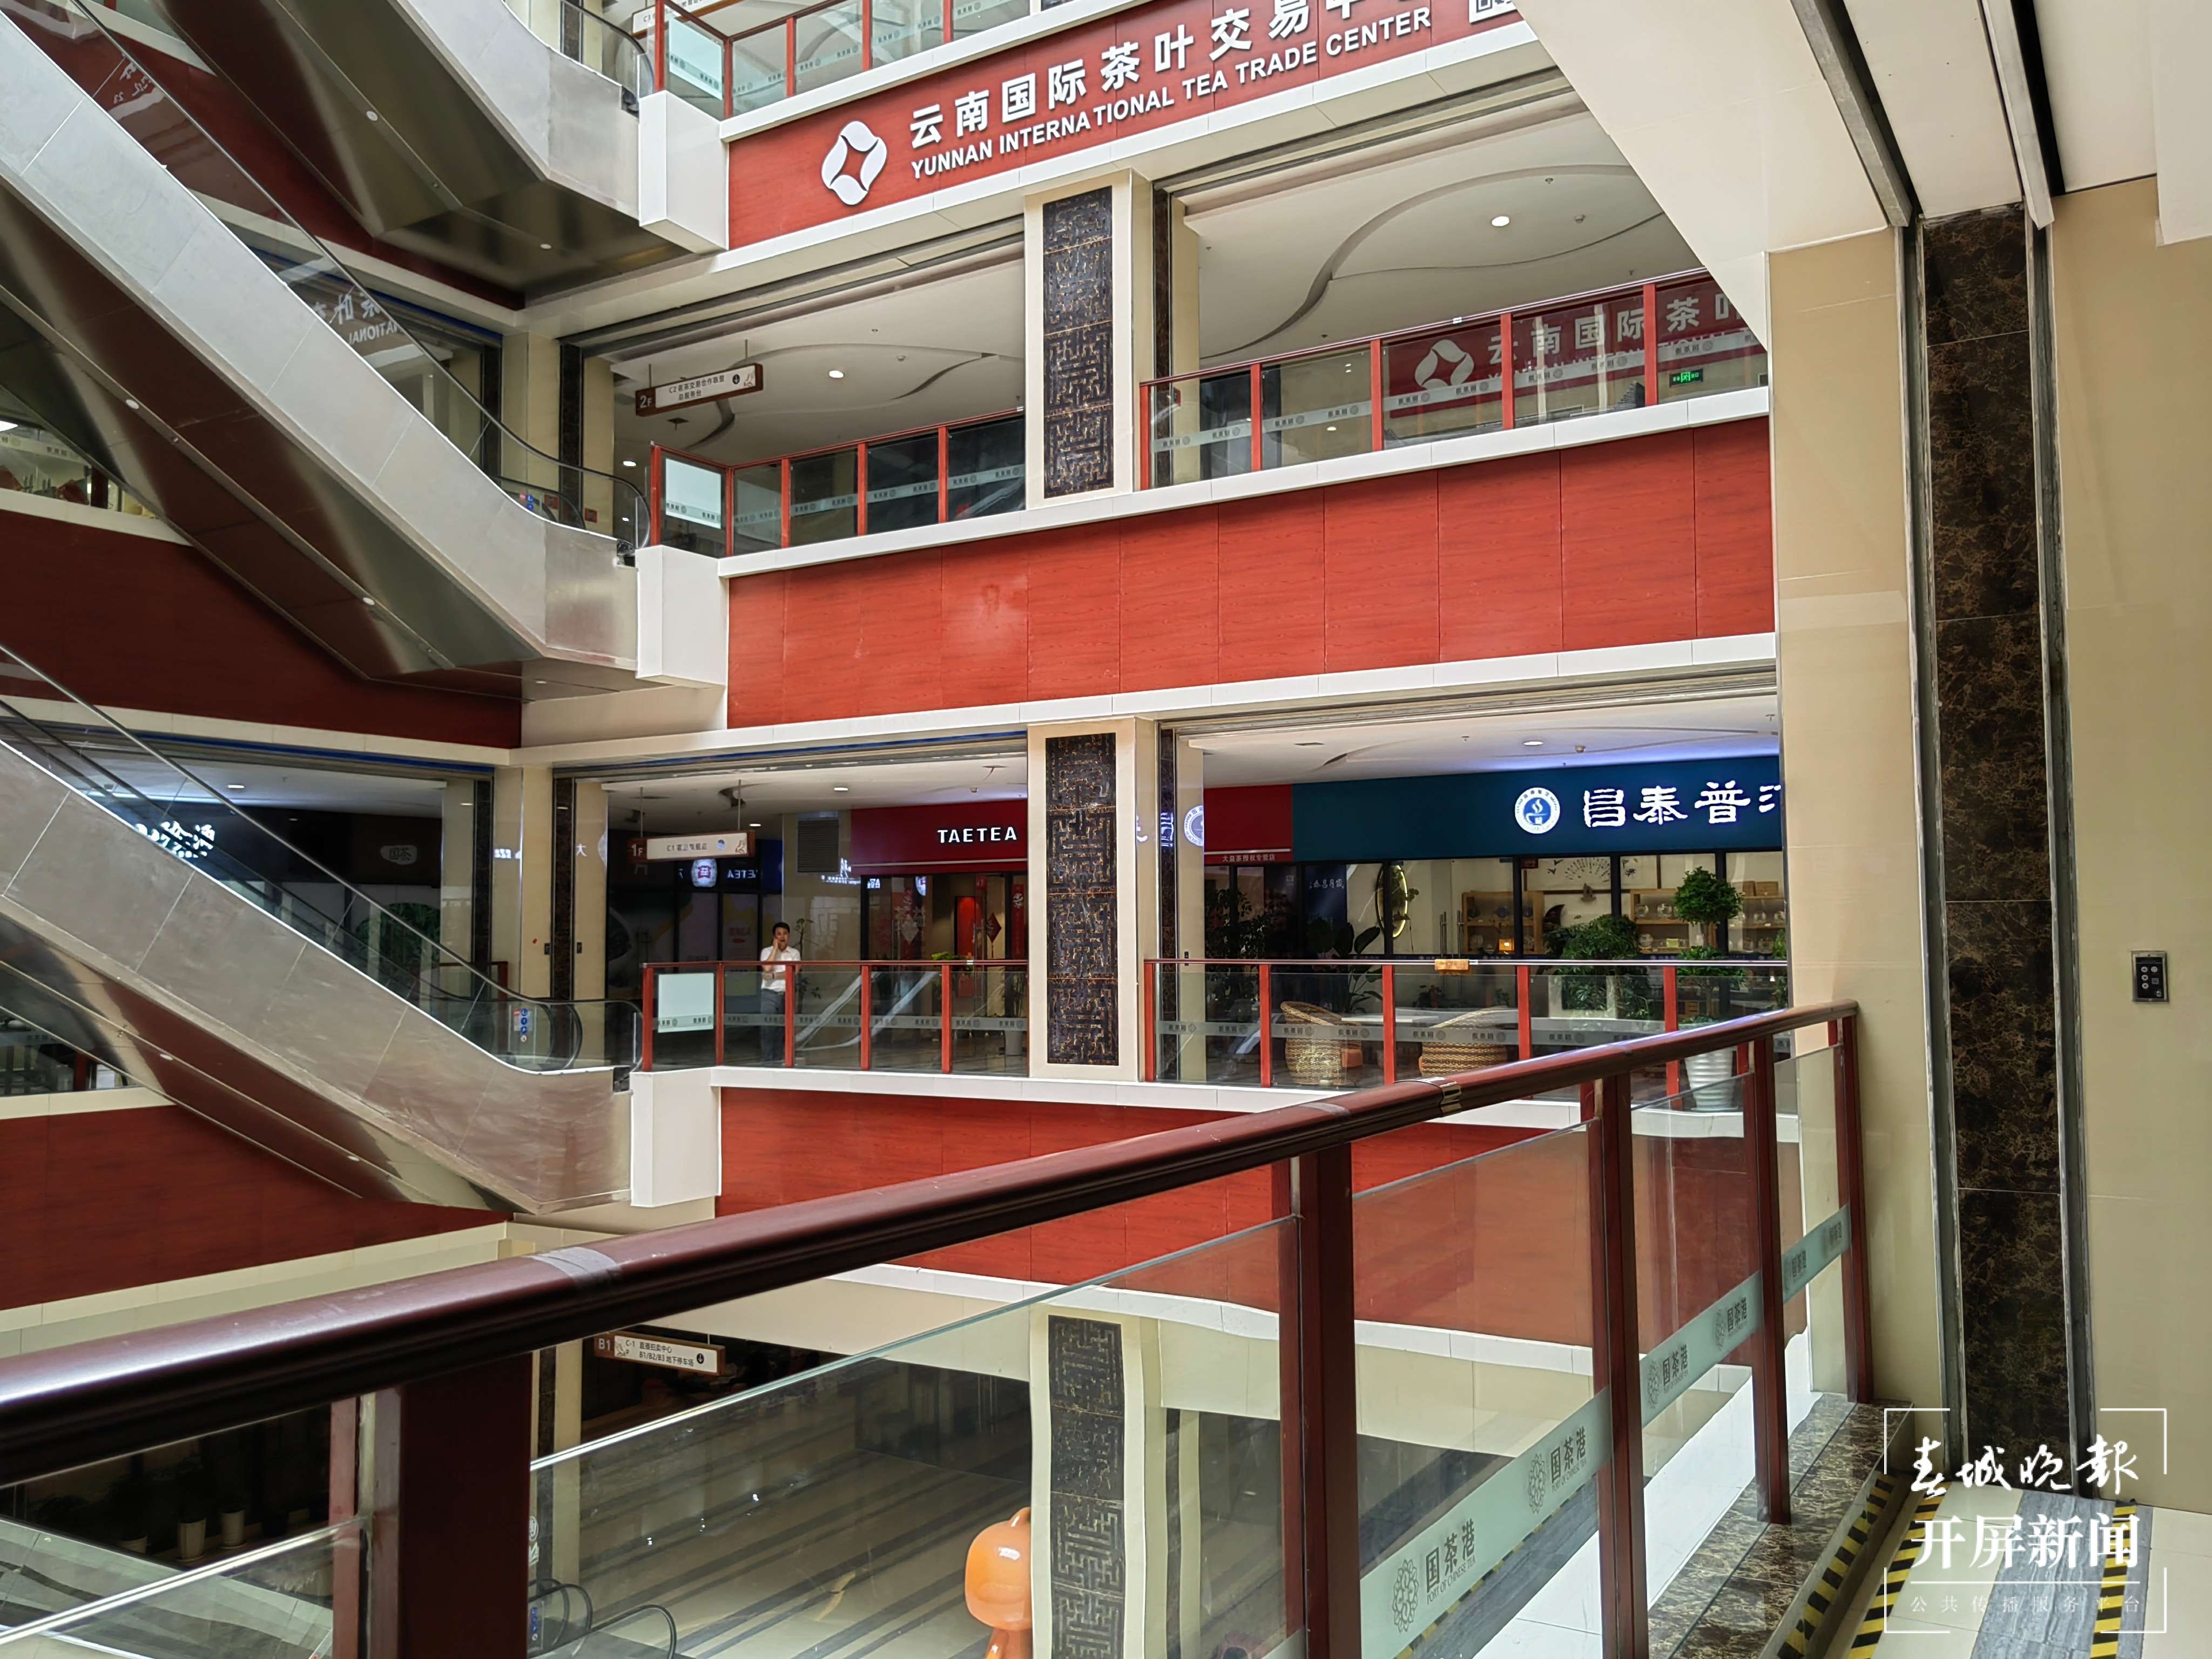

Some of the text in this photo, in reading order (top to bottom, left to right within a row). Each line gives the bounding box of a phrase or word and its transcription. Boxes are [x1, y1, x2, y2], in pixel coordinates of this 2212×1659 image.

[911, 6, 1432, 179] YUNNAN INTERNATIONAL TEA TRADE CENTER
[639, 395, 652, 408] 2F
[937, 826, 1017, 844] TAETEA
[631, 844, 643, 857] 1F
[598, 1338, 611, 1350] B1
[625, 1340, 635, 1348] C-1
[639, 1351, 665, 1362] B1/B2/B3
[1663, 1343, 1688, 1387] 国茶港
[1550, 1426, 1586, 1484] 国茶港
[1426, 1518, 1475, 1594] 国茶港
[1426, 1556, 1476, 1605] PORT OF CHINESE TEA
